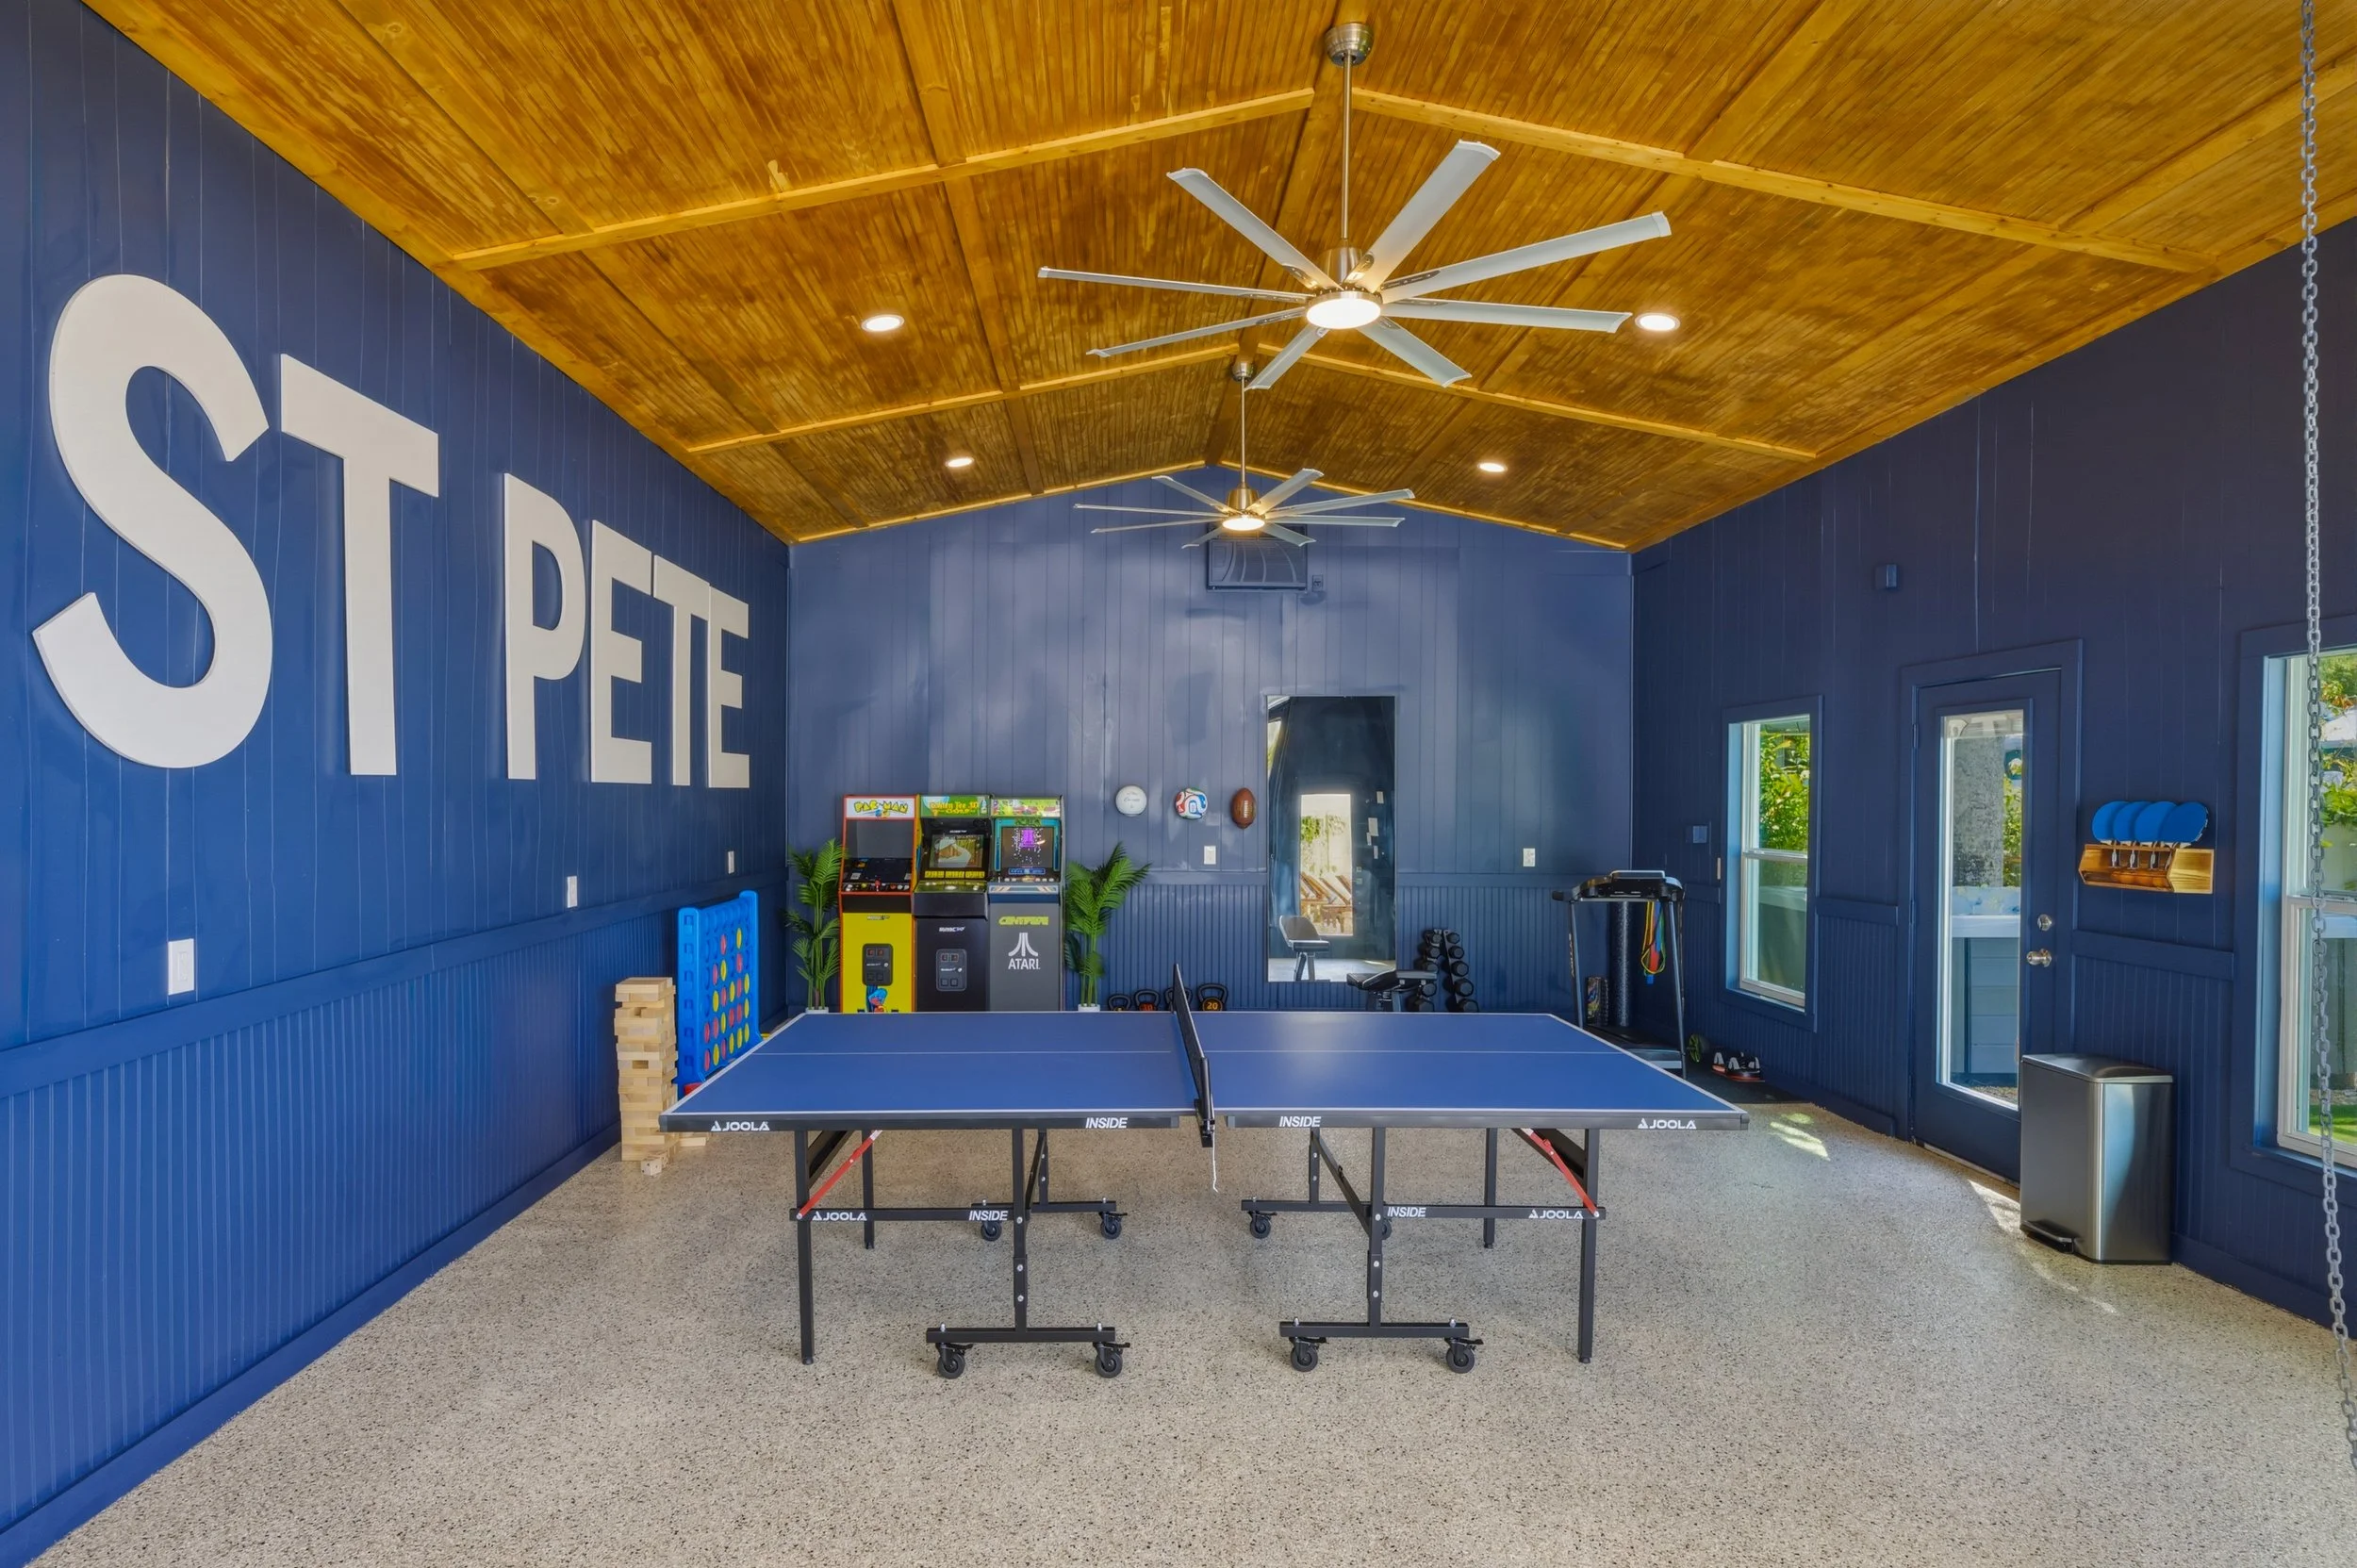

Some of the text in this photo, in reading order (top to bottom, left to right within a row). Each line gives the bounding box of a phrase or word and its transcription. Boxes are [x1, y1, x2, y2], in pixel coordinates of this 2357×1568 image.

[32, 273, 750, 789] ST PETE
[1008, 958, 1040, 970] ATARI
[1206, 1001, 1218, 1010] 20
[722, 1120, 770, 1131] JOOLA
[1085, 1116, 1129, 1129] INSIDE
[1278, 1115, 1322, 1128] INSIDE
[1649, 1119, 1697, 1130] JOOLA
[822, 1212, 867, 1221] JOOLA
[968, 1210, 1009, 1221] INSIDE
[1387, 1206, 1427, 1217] INSIDE
[1539, 1210, 1584, 1219] JOOLA
